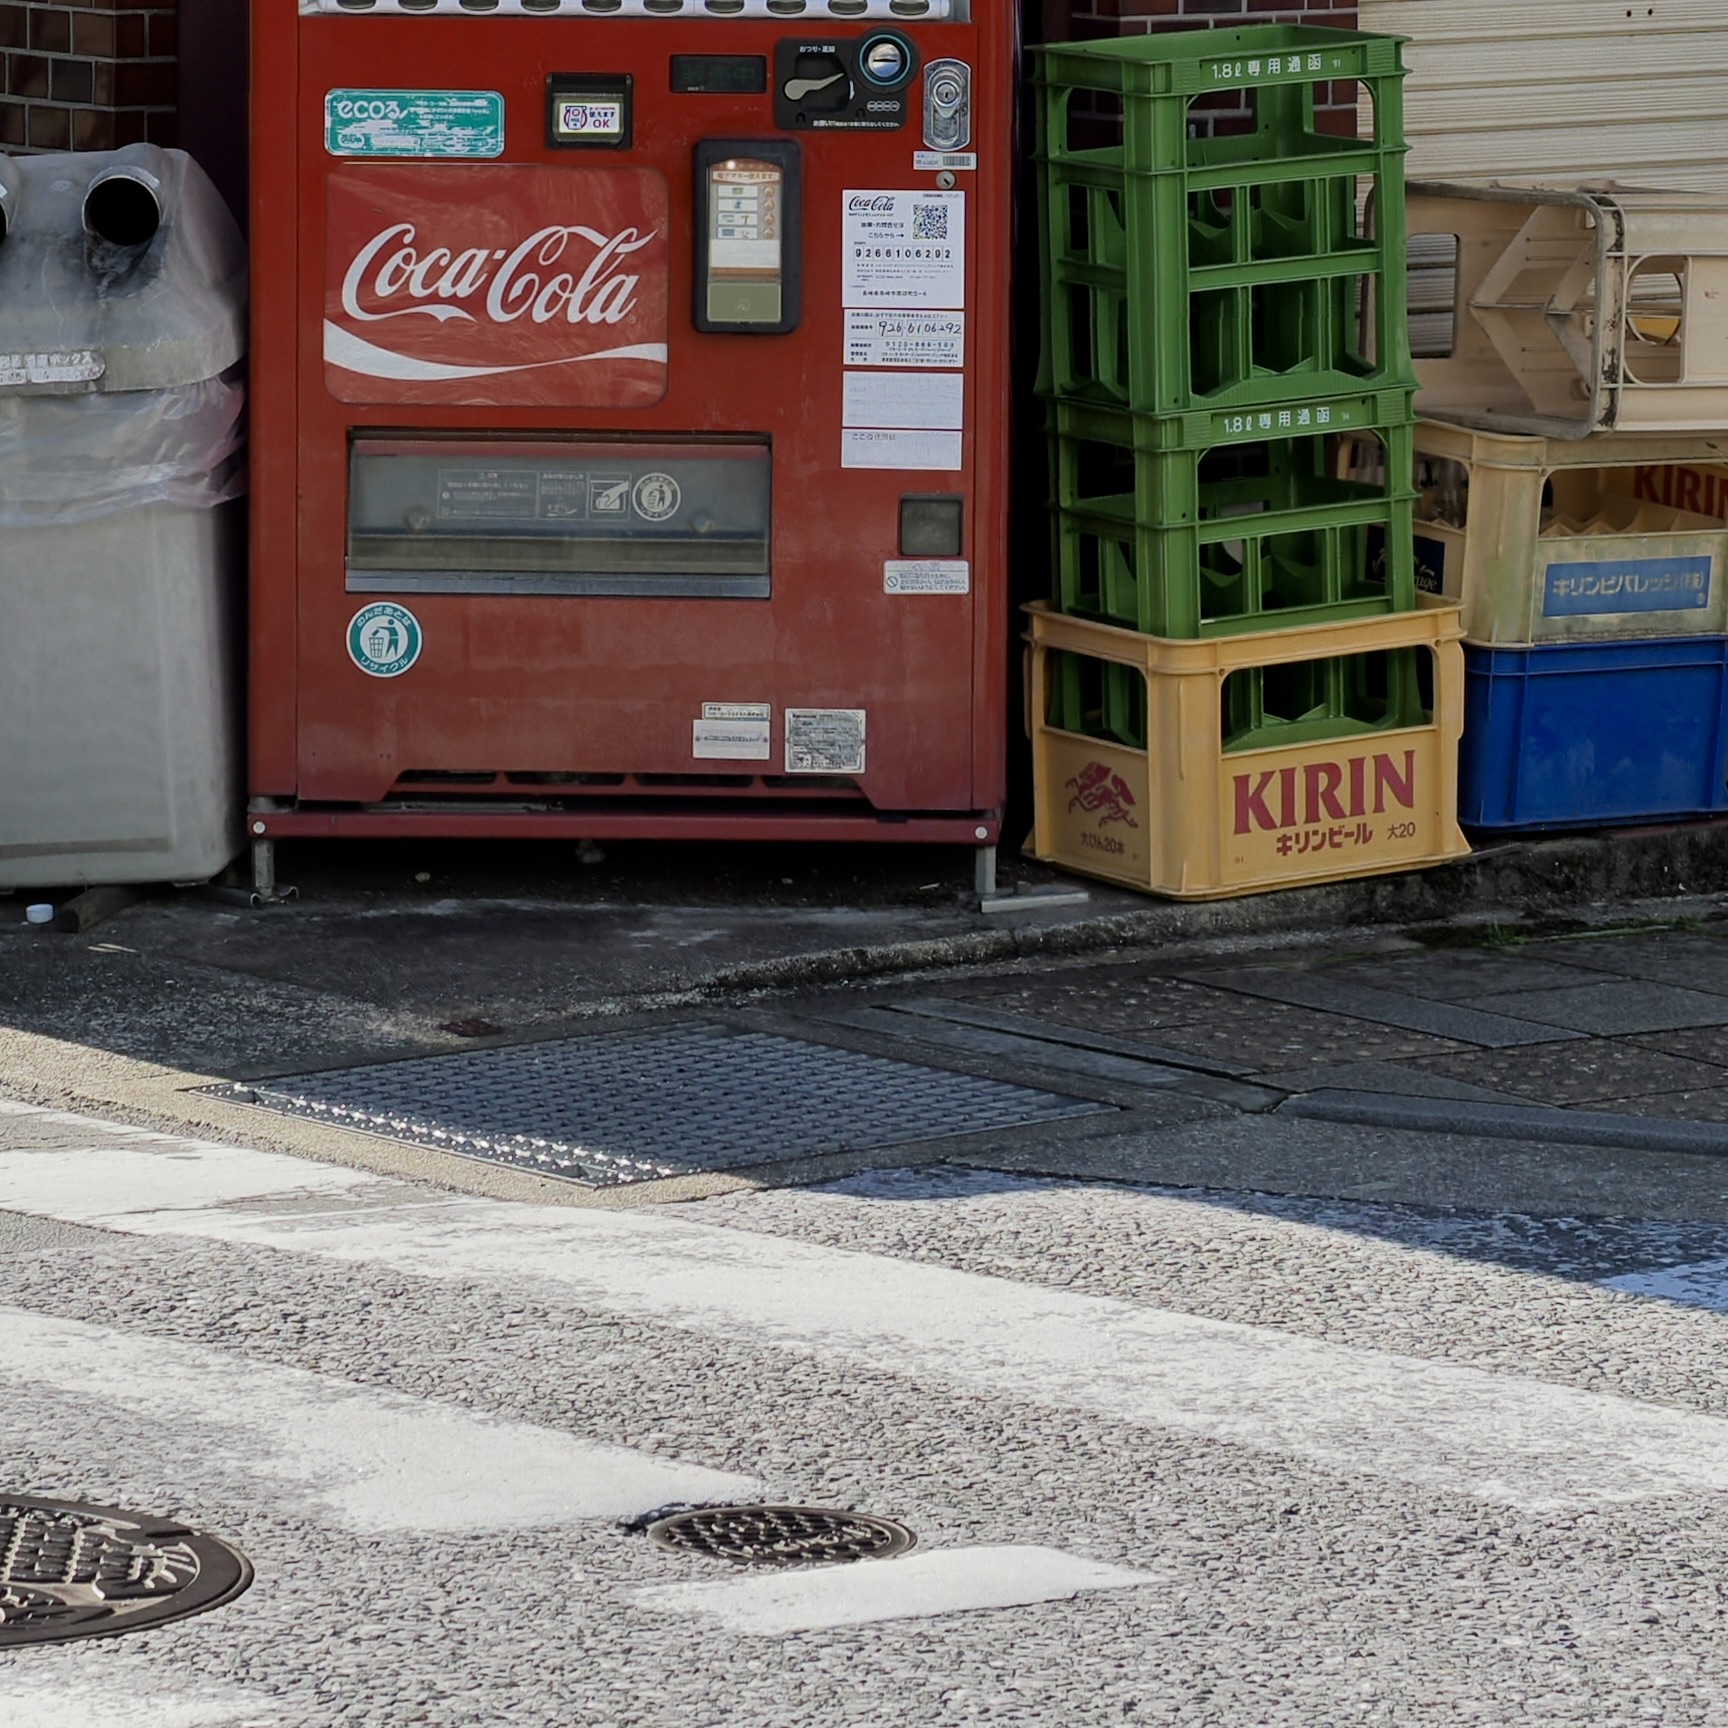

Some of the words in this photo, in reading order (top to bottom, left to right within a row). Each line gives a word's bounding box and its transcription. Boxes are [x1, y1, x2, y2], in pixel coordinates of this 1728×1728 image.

[592, 119, 610, 129] OK
[342, 222, 660, 325] Coca-Cola
[360, 655, 409, 673] リサイクル
[1232, 749, 1416, 836] KIRIN
[1080, 832, 1126, 855] 大びん20本
[1275, 823, 1373, 857] キリンビール
[1386, 822, 1416, 841] 大20
